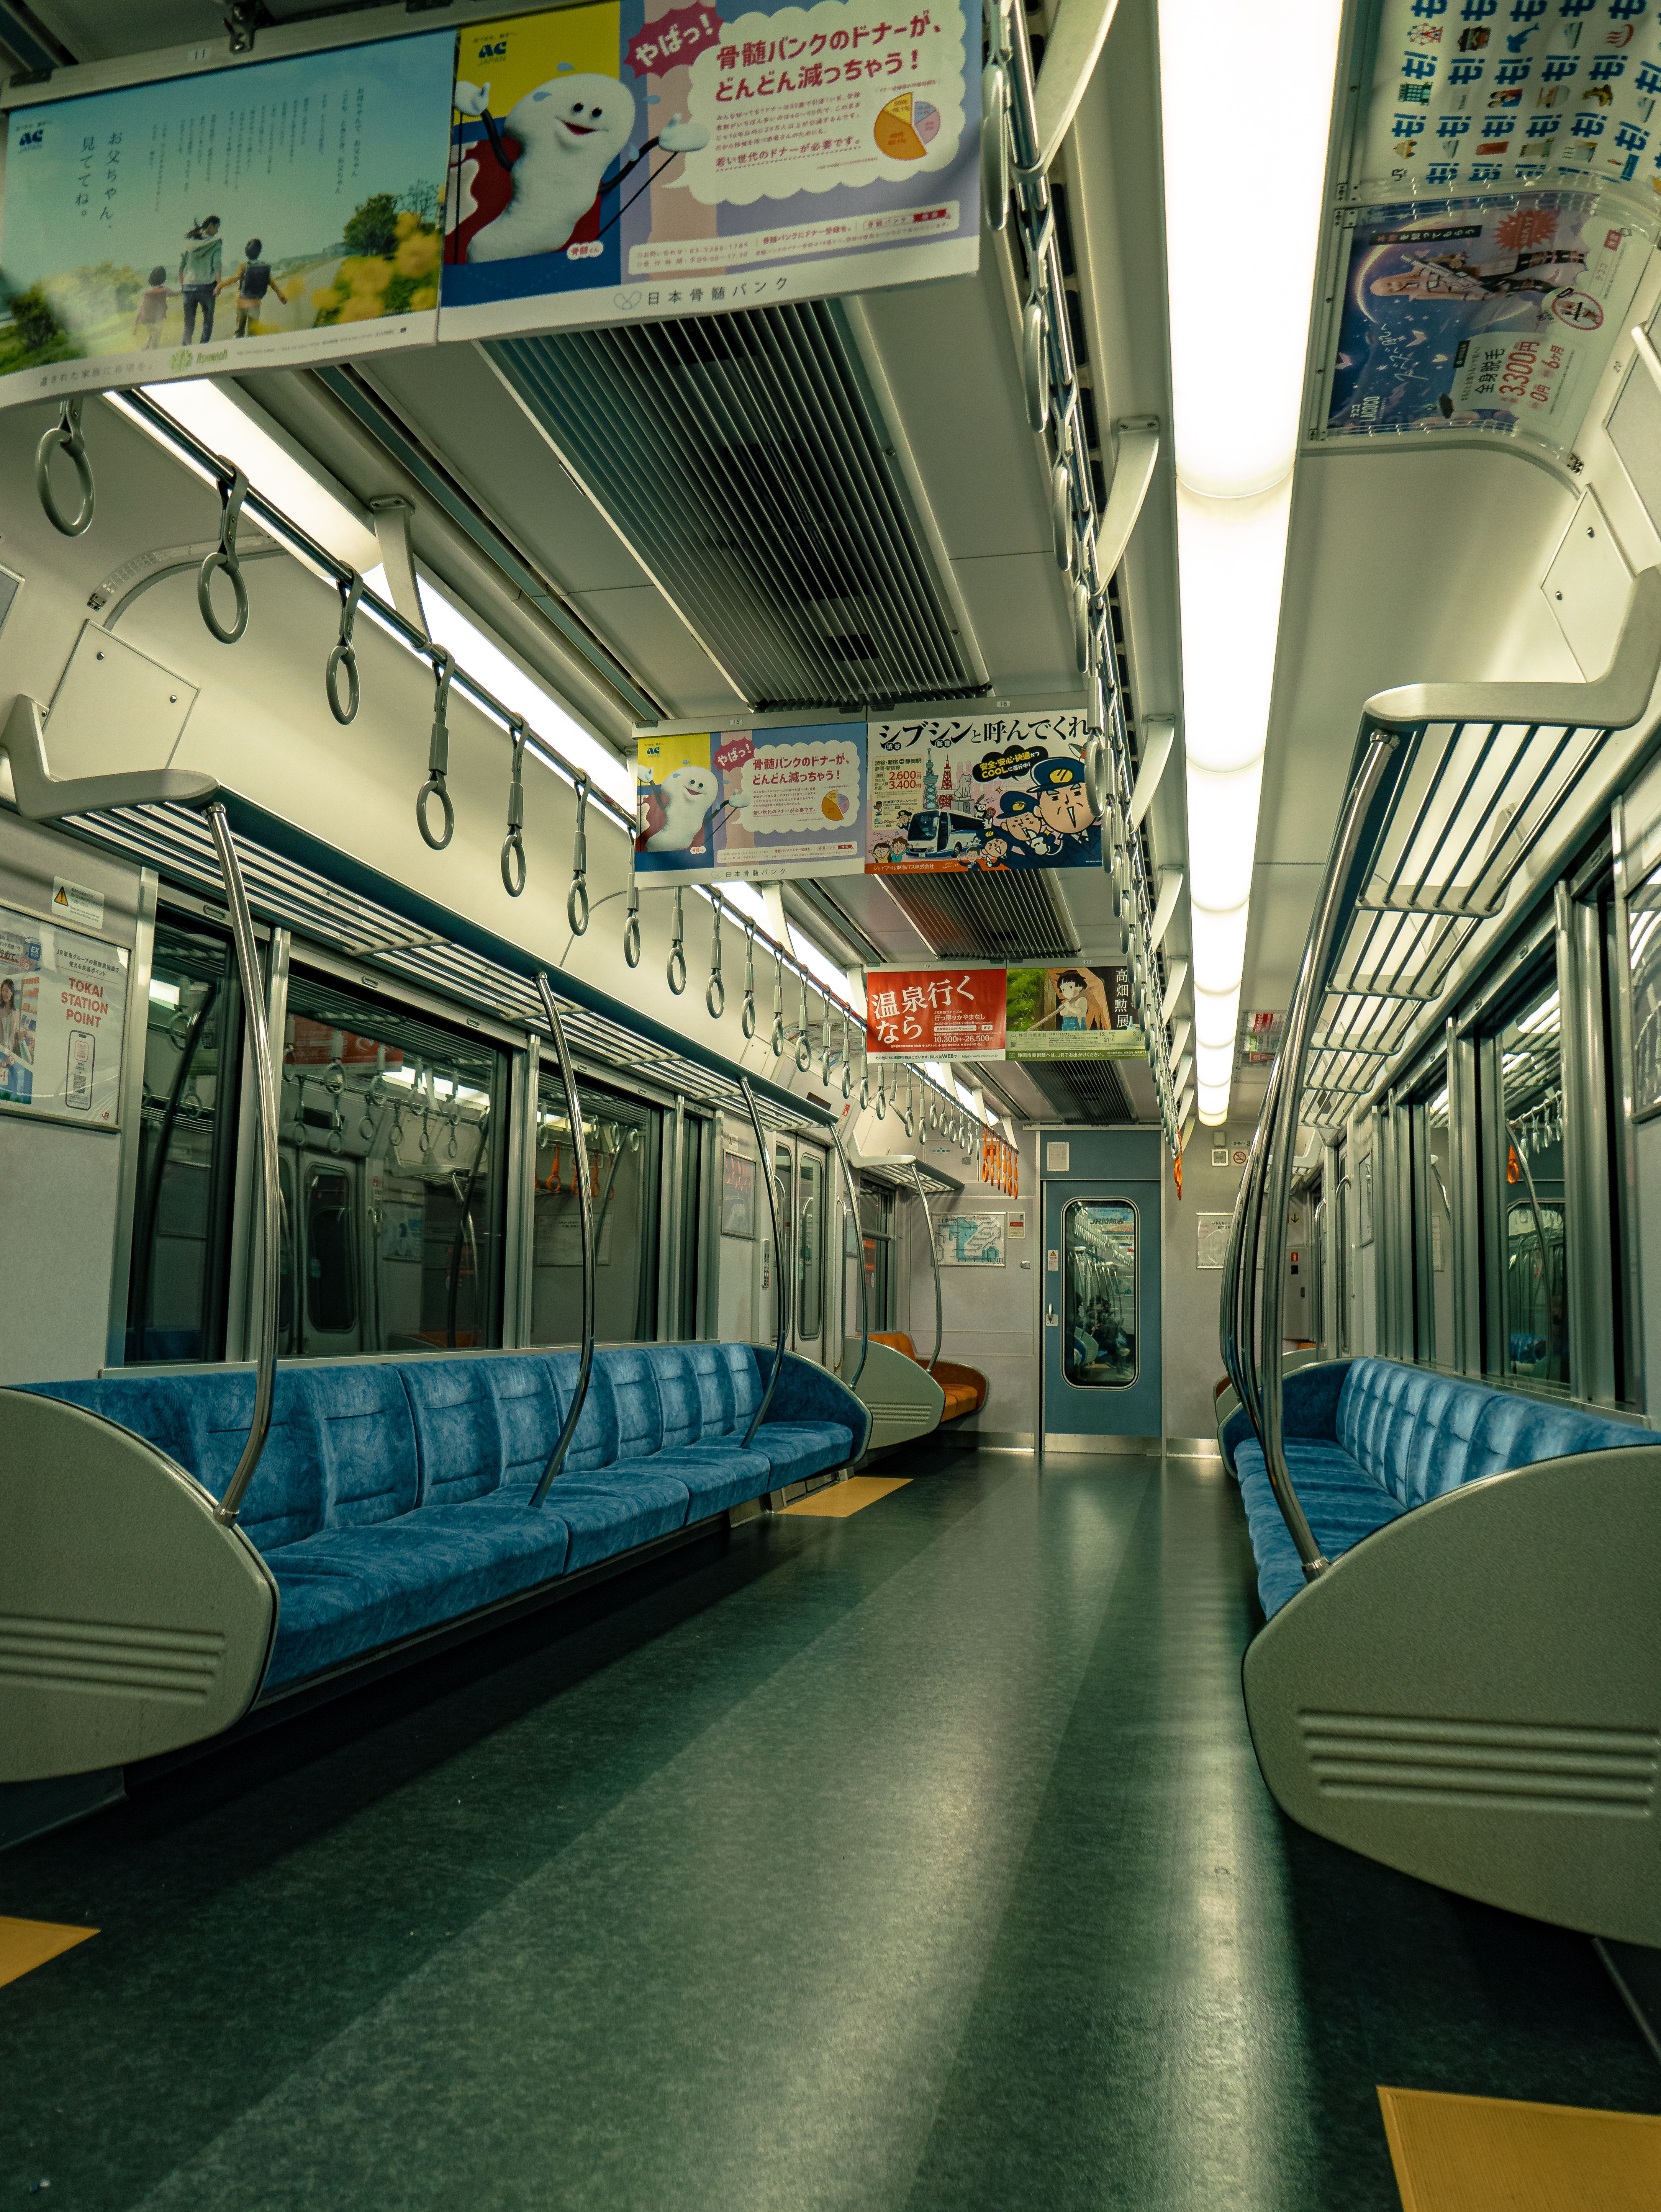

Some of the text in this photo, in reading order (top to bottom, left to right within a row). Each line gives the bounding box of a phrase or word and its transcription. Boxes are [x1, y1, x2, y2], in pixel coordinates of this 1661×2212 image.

[478, 41, 506, 58] AC
[717, 10, 942, 70] 骨髄バンクのドナーが、
[477, 56, 506, 66] JAPAN
[716, 50, 919, 102] どんどん減っちゃう！
[716, 135, 860, 167] 若い世代のドナーが必要です。
[75, 136, 95, 218] 見ててね。
[100, 132, 123, 229] お父ちゃん、
[648, 277, 787, 305] 日本骨髄バンク
[1474, 348, 1505, 394] 全身脱毛
[1499, 341, 1540, 396] 3,300円
[1350, 404, 1361, 418] ラココ
[1359, 396, 1381, 422] LACOCO
[886, 742, 901, 750] 渋谷
[936, 739, 951, 748] 新宿
[753, 752, 850, 771] 骨髄バンクのドナーが、
[980, 751, 1040, 771] 安全・安心・快適かつ
[981, 761, 1031, 779] COOLに運行中！
[752, 770, 840, 785] どんどん減っちゃう！
[888, 779, 921, 790] 3,400円
[753, 807, 816, 815] 若い世代のドナーが必要です。
[726, 868, 786, 878] 日本骨髄バンク
[31, 946, 40, 954] EX
[56, 949, 119, 973] JR東海グループの駅商業施設で
[69, 961, 106, 977] 使える共通ポイント
[69, 977, 103, 998] TOKAI
[871, 975, 975, 1020] 温泉行く
[61, 991, 108, 1014] STATION
[1114, 969, 1129, 1028] 高畑勲展
[66, 1009, 102, 1028] POINT
[876, 1016, 922, 1044] なら
